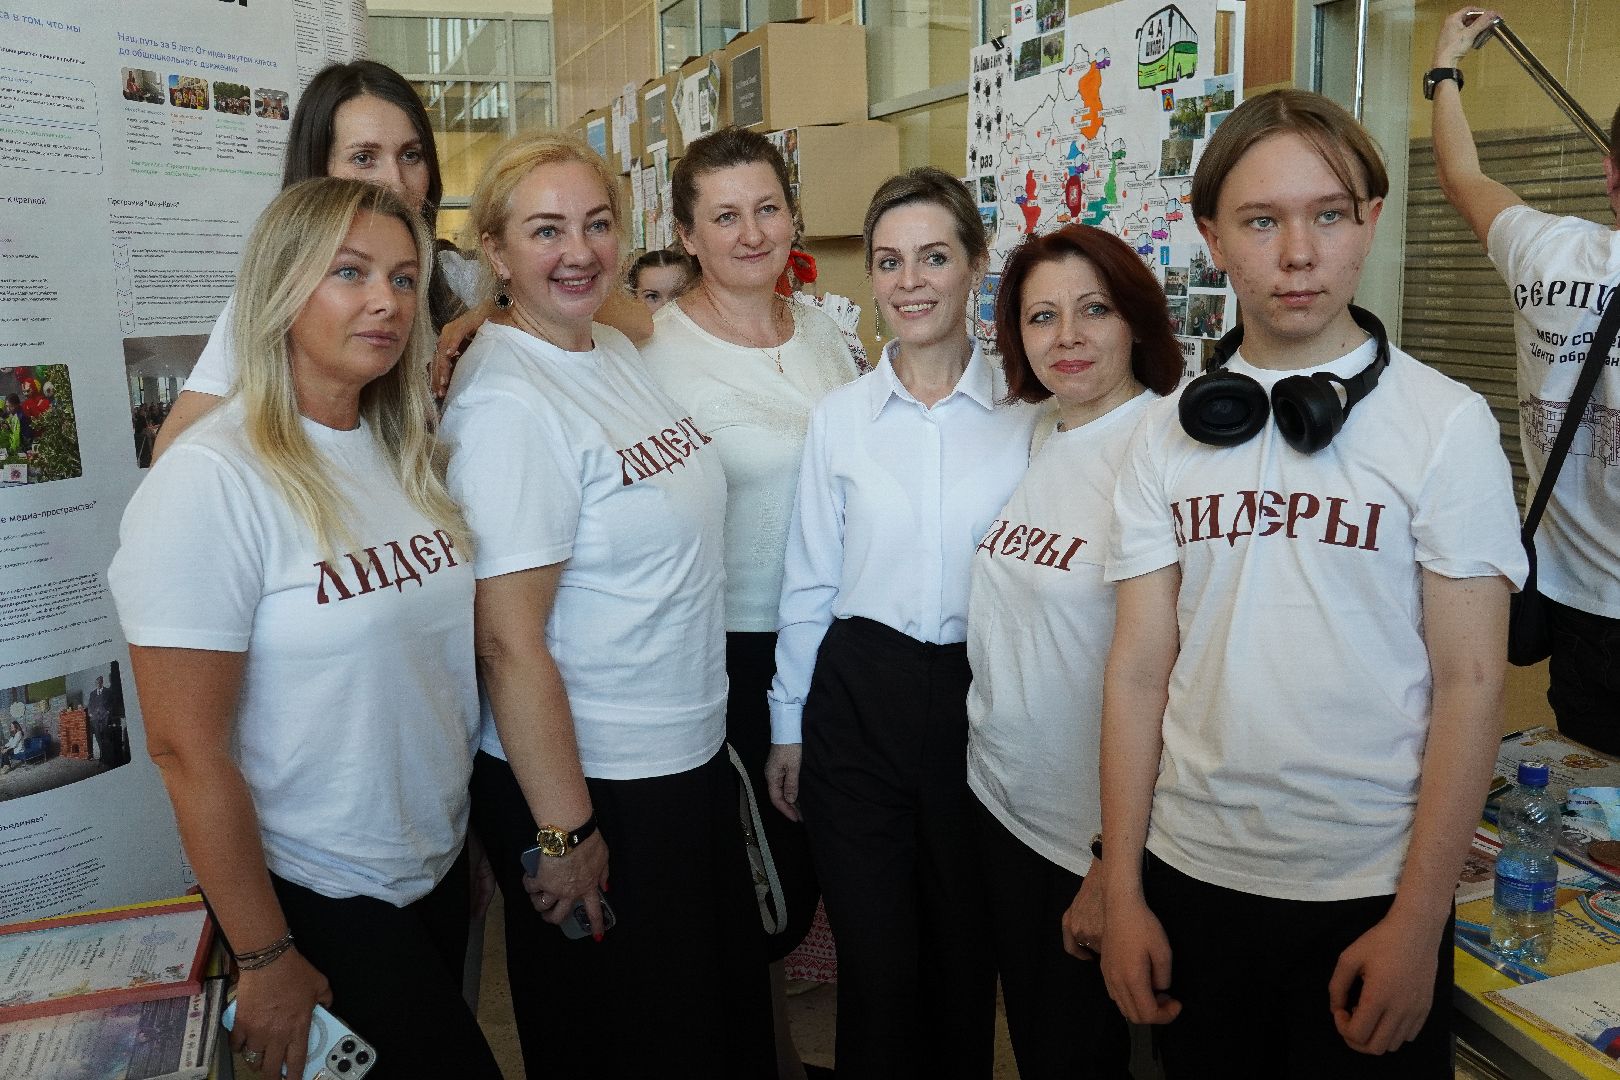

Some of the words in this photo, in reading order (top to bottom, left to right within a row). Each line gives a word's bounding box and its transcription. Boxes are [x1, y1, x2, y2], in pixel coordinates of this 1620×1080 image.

[22, 16, 43, 28] том,
[47, 21, 63, 31] что
[67, 25, 81, 33] мы
[119, 47, 130, 57] до
[139, 37, 159, 49] путь
[161, 41, 170, 50] за
[171, 42, 177, 50] 5
[980, 154, 993, 173] раз
[1536, 328, 1568, 347] МБОУ
[1572, 331, 1597, 347] СО
[975, 519, 1088, 572] ДЕРЫ
